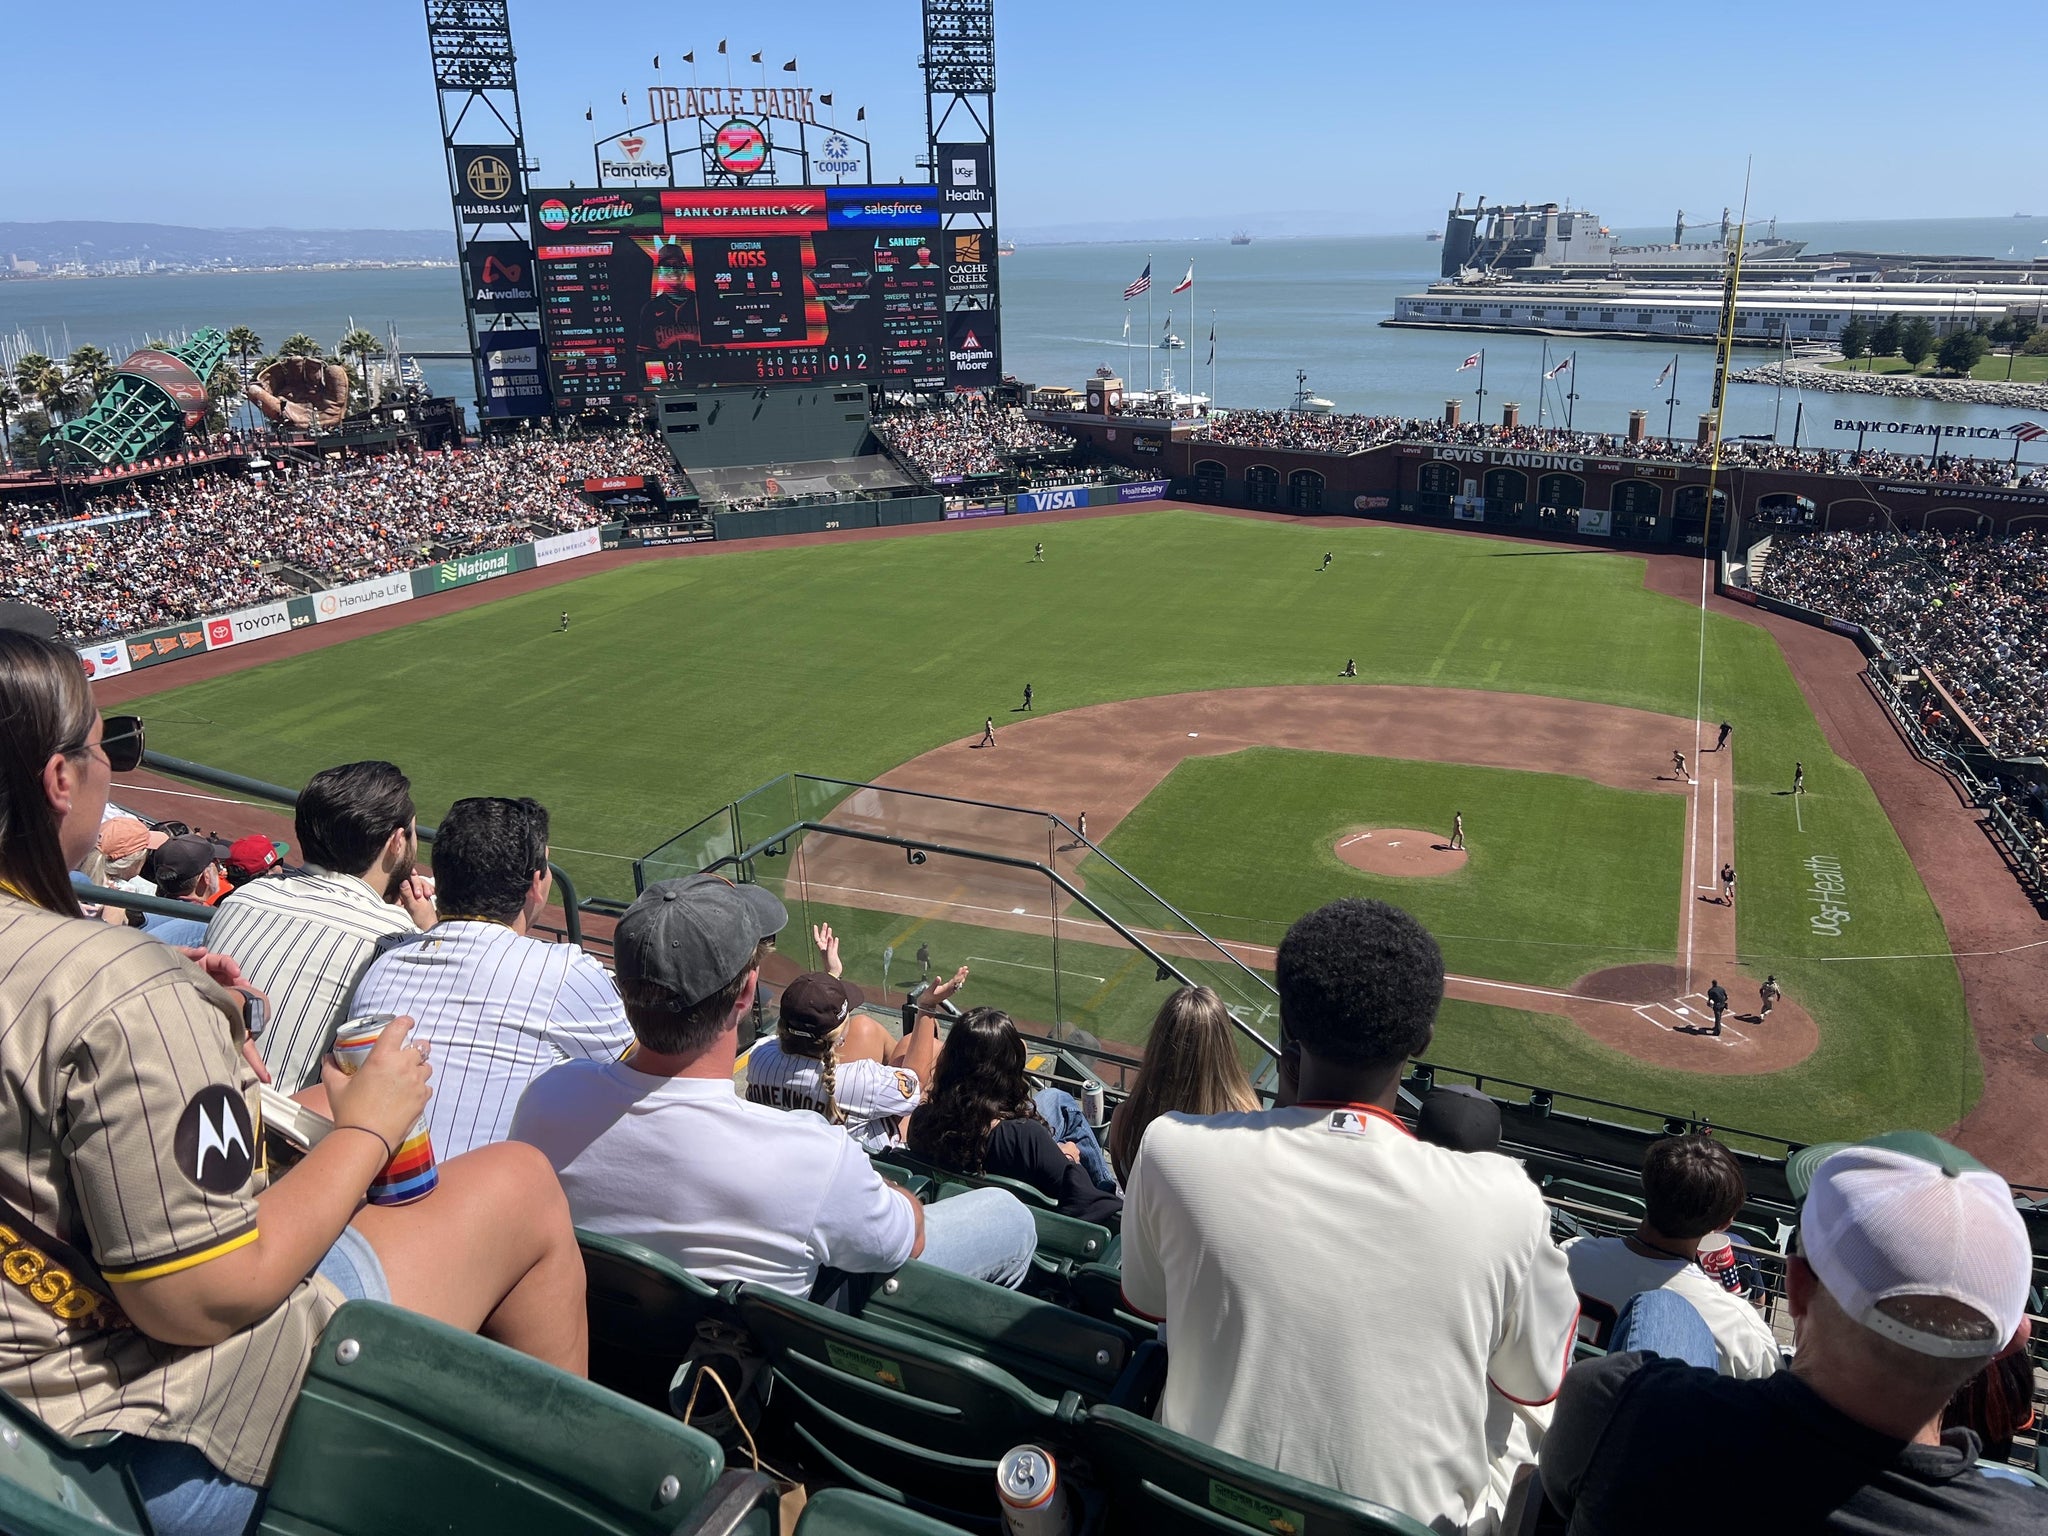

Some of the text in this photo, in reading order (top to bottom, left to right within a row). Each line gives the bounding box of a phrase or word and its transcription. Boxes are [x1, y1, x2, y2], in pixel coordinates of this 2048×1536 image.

[648, 87, 816, 124] ORACLE PARK
[602, 162, 668, 178] Fanatics
[819, 161, 857, 175] coupa
[955, 167, 974, 178] UCSF
[945, 189, 985, 201] Health
[463, 204, 522, 214] HABBAS LAW
[571, 200, 634, 224] Electric
[674, 206, 788, 217] BANK OF AMERICA
[864, 202, 922, 217] salesforce
[730, 242, 761, 250] CHRISTIAN
[888, 237, 904, 247] SAN
[546, 244, 610, 256] SAN FRANCISCO
[727, 250, 767, 268] KOSS
[948, 264, 988, 274] CACHE
[772, 272, 778, 281] 9
[949, 274, 987, 284] CREEK
[477, 288, 532, 300] Airwallex
[494, 354, 532, 364] StubHub
[949, 349, 993, 362] Benjamin
[668, 355, 817, 370] 0 2 2 4 0 4 4 2
[829, 354, 867, 370] 0 1 2
[956, 361, 988, 371] Moore
[669, 373, 674, 381] 2
[679, 372, 682, 380] 1
[758, 368, 764, 377] 3
[768, 368, 774, 376] 3
[778, 368, 784, 376] 0
[792, 367, 798, 375] 0
[813, 366, 816, 374] 1
[510, 374, 540, 386] VERIFIED
[491, 386, 543, 398] GIANTS TICKETS
[1834, 419, 2001, 439] BANK OF AMERICA
[1491, 452, 1584, 472] LANDING
[602, 480, 627, 489] Adobe
[1030, 479, 1061, 488] WELCOME
[1122, 485, 1163, 496] HealthEquity
[1886, 485, 1927, 495] PRIZEPICKS
[1030, 491, 1076, 511] VISA
[825, 521, 840, 529] 391
[603, 541, 619, 549] 399
[1686, 535, 1703, 544] 309
[538, 550, 553, 558] BANK
[562, 542, 587, 553] AMERICA
[458, 553, 509, 578] National
[476, 567, 508, 581] Car Rental
[339, 580, 408, 608] Hanwha Life
[235, 613, 286, 633] TOYOTA
[291, 615, 310, 627] 354
[1802, 855, 1848, 905] Health
[1810, 904, 1852, 937] UCSF
